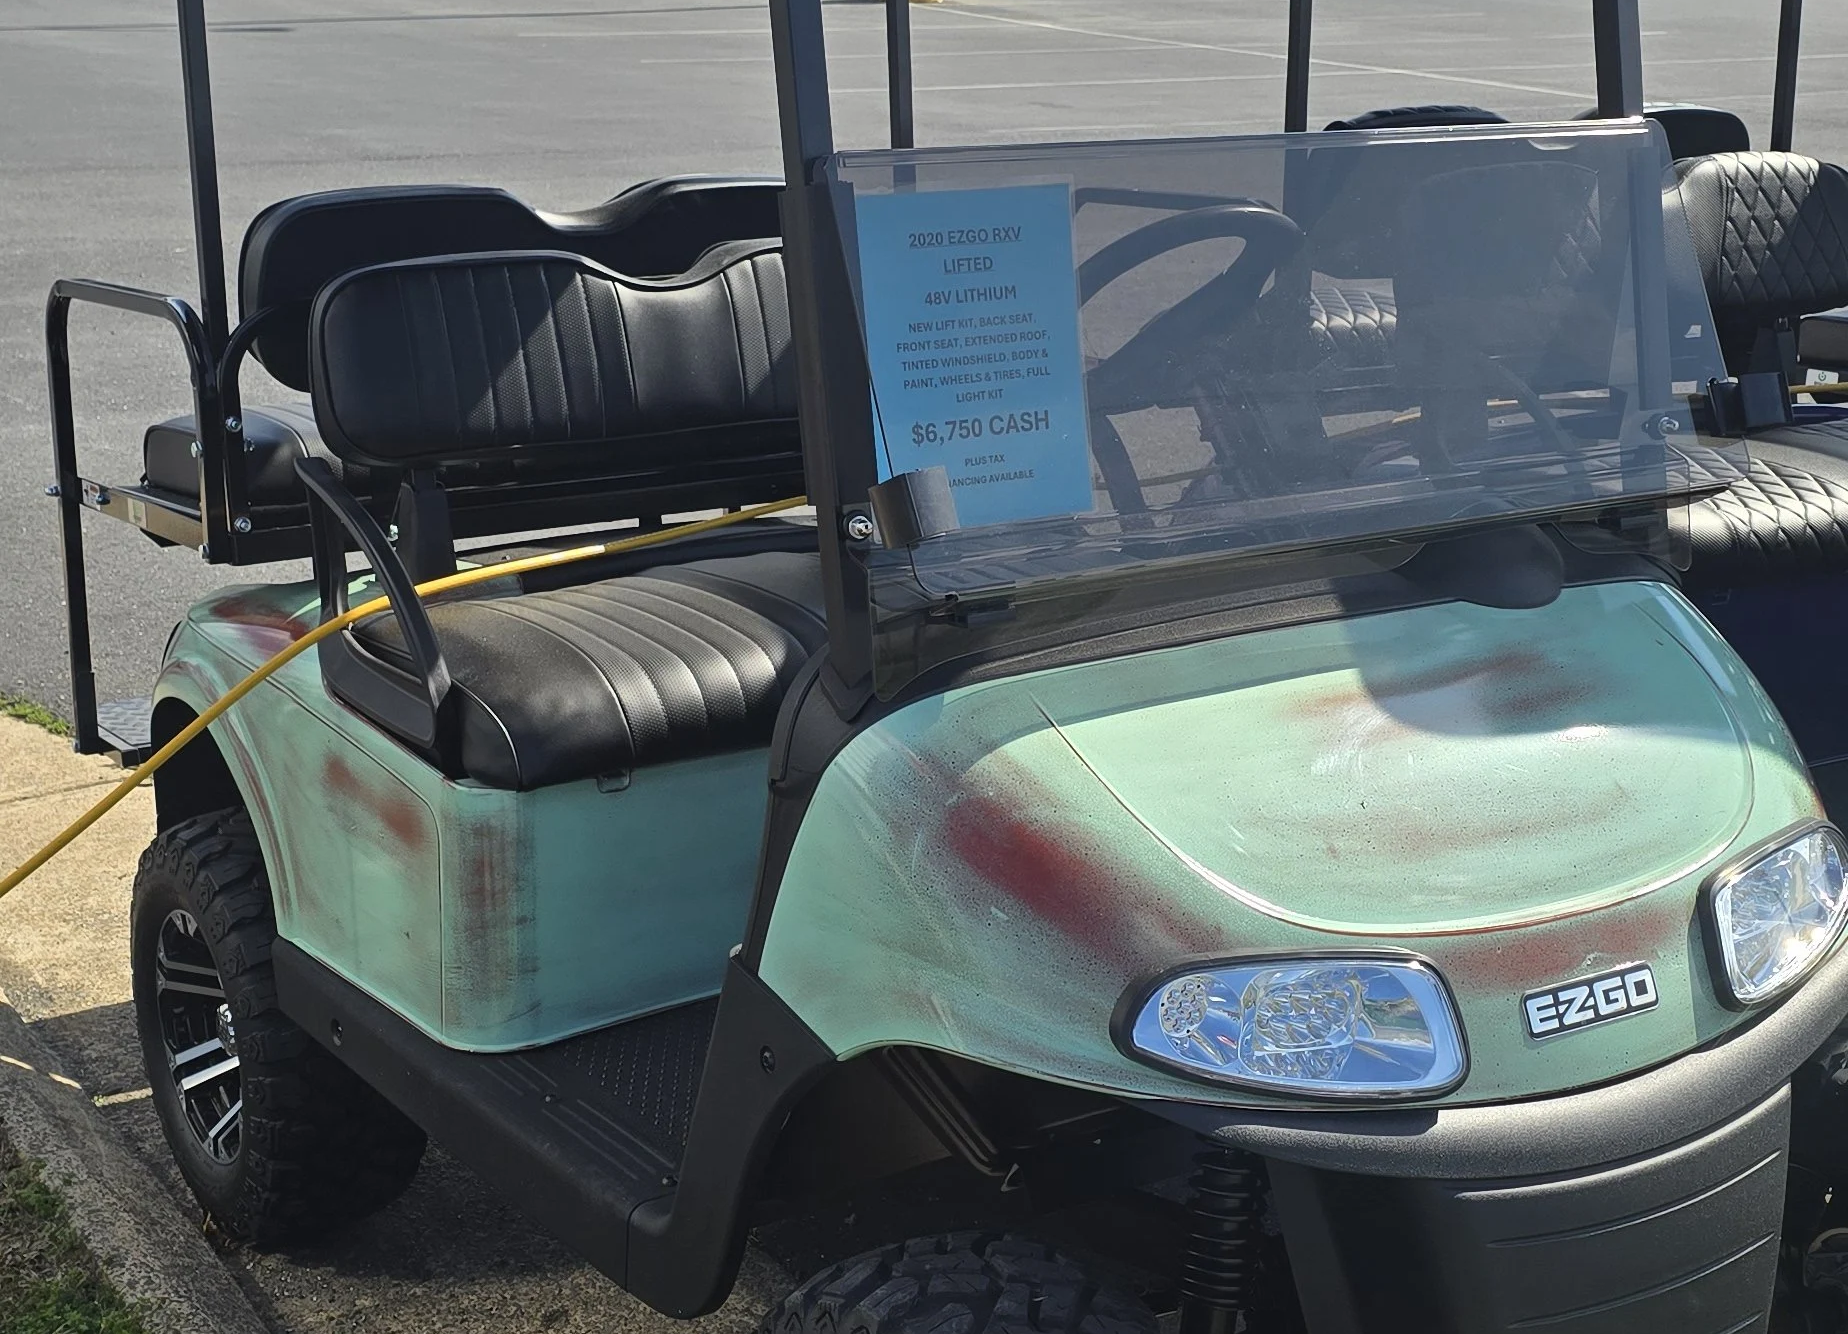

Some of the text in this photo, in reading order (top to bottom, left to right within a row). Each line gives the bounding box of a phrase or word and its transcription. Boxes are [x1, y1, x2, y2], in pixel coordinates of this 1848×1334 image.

[908, 226, 1022, 248] 2020 EZGO RXV
[943, 256, 994, 274] LIFTED
[924, 285, 1017, 306] 48V LITHIUM
[908, 322, 933, 334] NEW
[935, 320, 956, 331] LIFT
[958, 318, 977, 329] KIT,
[979, 315, 1007, 327] BACK
[896, 330, 1051, 353] FRONT SEAT, EXTENDED ROOF,
[902, 348, 1049, 372] TINTED WINDSHIELD, BODY &
[903, 366, 1051, 390] PAINT, WHEELS & TIRES, FULL
[956, 389, 1004, 403] LIGHT KIT
[911, 409, 1050, 447] $6,750 CASH
[964, 454, 1005, 467] PLUS TAX
[988, 469, 1035, 483] AVAILABLE
